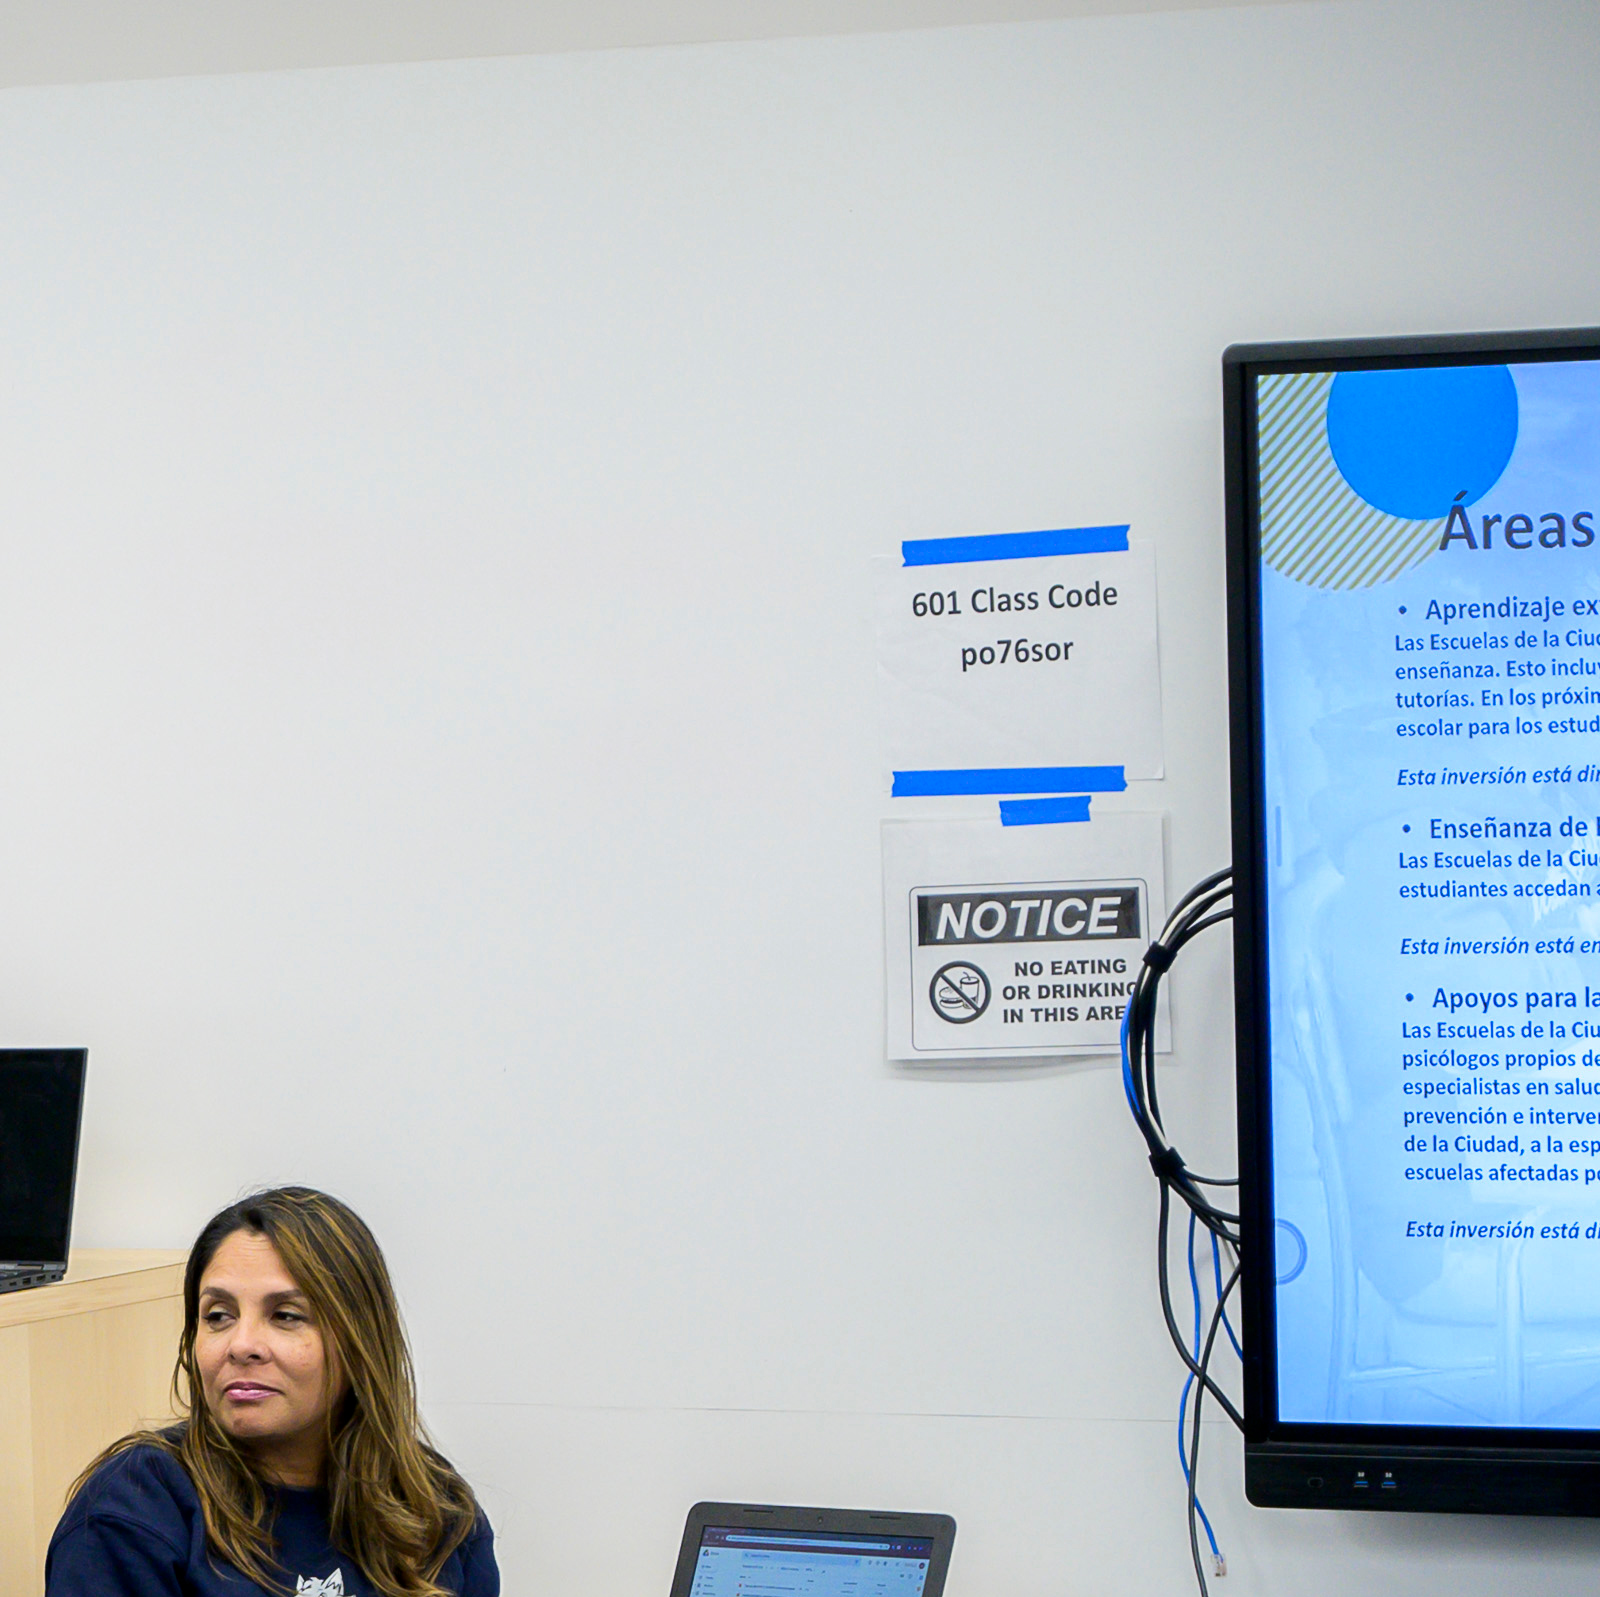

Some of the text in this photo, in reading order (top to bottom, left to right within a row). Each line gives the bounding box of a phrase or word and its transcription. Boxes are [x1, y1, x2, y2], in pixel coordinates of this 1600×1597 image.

[1439, 490, 1594, 551] Áreas
[913, 581, 1117, 616] 601 Class Code
[1426, 596, 1564, 625] Aprendizaje
[1396, 630, 1559, 651] Las Escuelas de la
[962, 639, 1073, 672] po76sor
[1396, 661, 1546, 679] enseñanza. Esto
[1396, 688, 1535, 708] tutorías. En los
[1397, 715, 1600, 738] escolar para los estud
[1398, 765, 1571, 785] Esta inversión está
[1431, 816, 1587, 838] Enseñanza de
[1400, 879, 1590, 898] estudiantes accedan
[936, 896, 1122, 940] NOTICE
[1015, 959, 1126, 976] NO EATING
[1002, 984, 1031, 1000] OR
[1433, 988, 1576, 1013] Apoyos para
[1003, 1005, 1125, 1024] IN THIS ARE
[1403, 1049, 1575, 1070] psicólogos propios
[1403, 1078, 1548, 1098] especialistas en
[1405, 1163, 1578, 1181] escuelas afectadas
